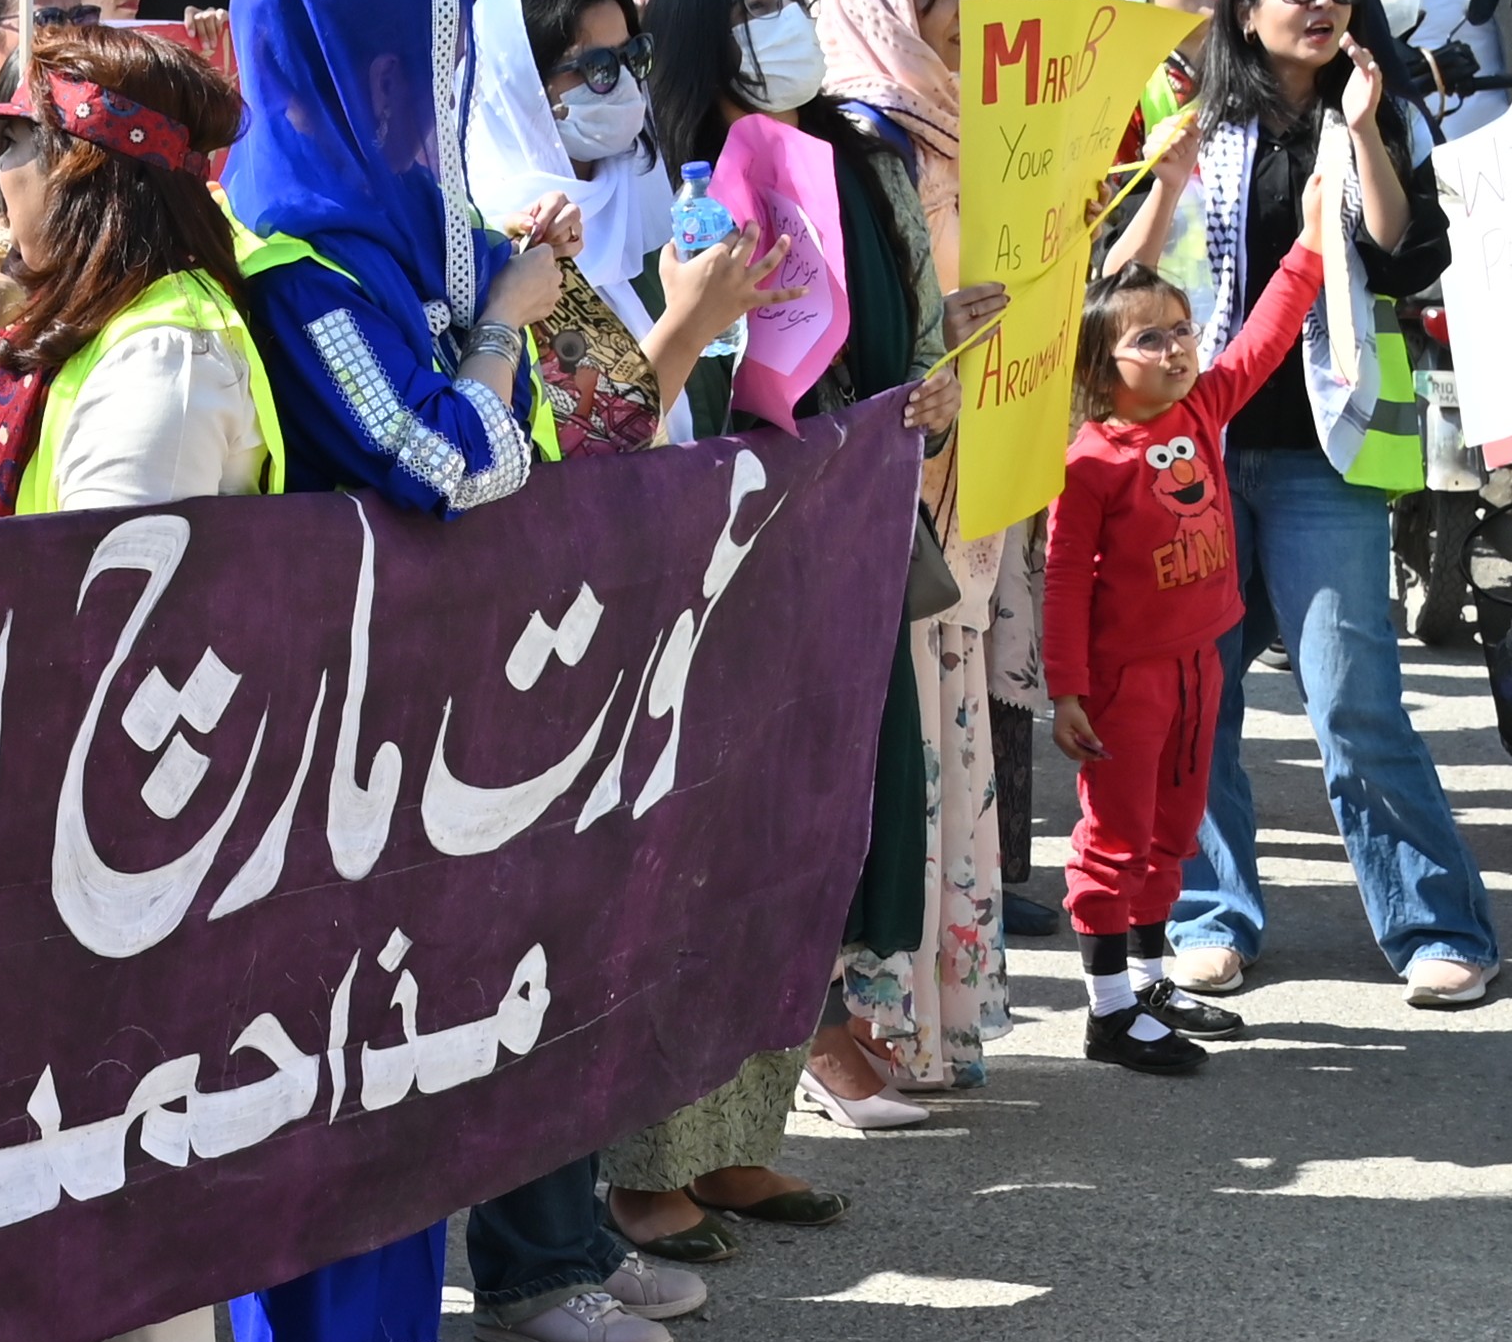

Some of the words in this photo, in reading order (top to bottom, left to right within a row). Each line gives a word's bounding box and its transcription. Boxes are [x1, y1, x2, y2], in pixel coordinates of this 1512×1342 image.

[999, 123, 1054, 183] YOUR
[994, 224, 1022, 272] AS
[1152, 527, 1230, 591] ELM
[419, 449, 788, 857] عورت
[50, 491, 403, 959] مارچ
